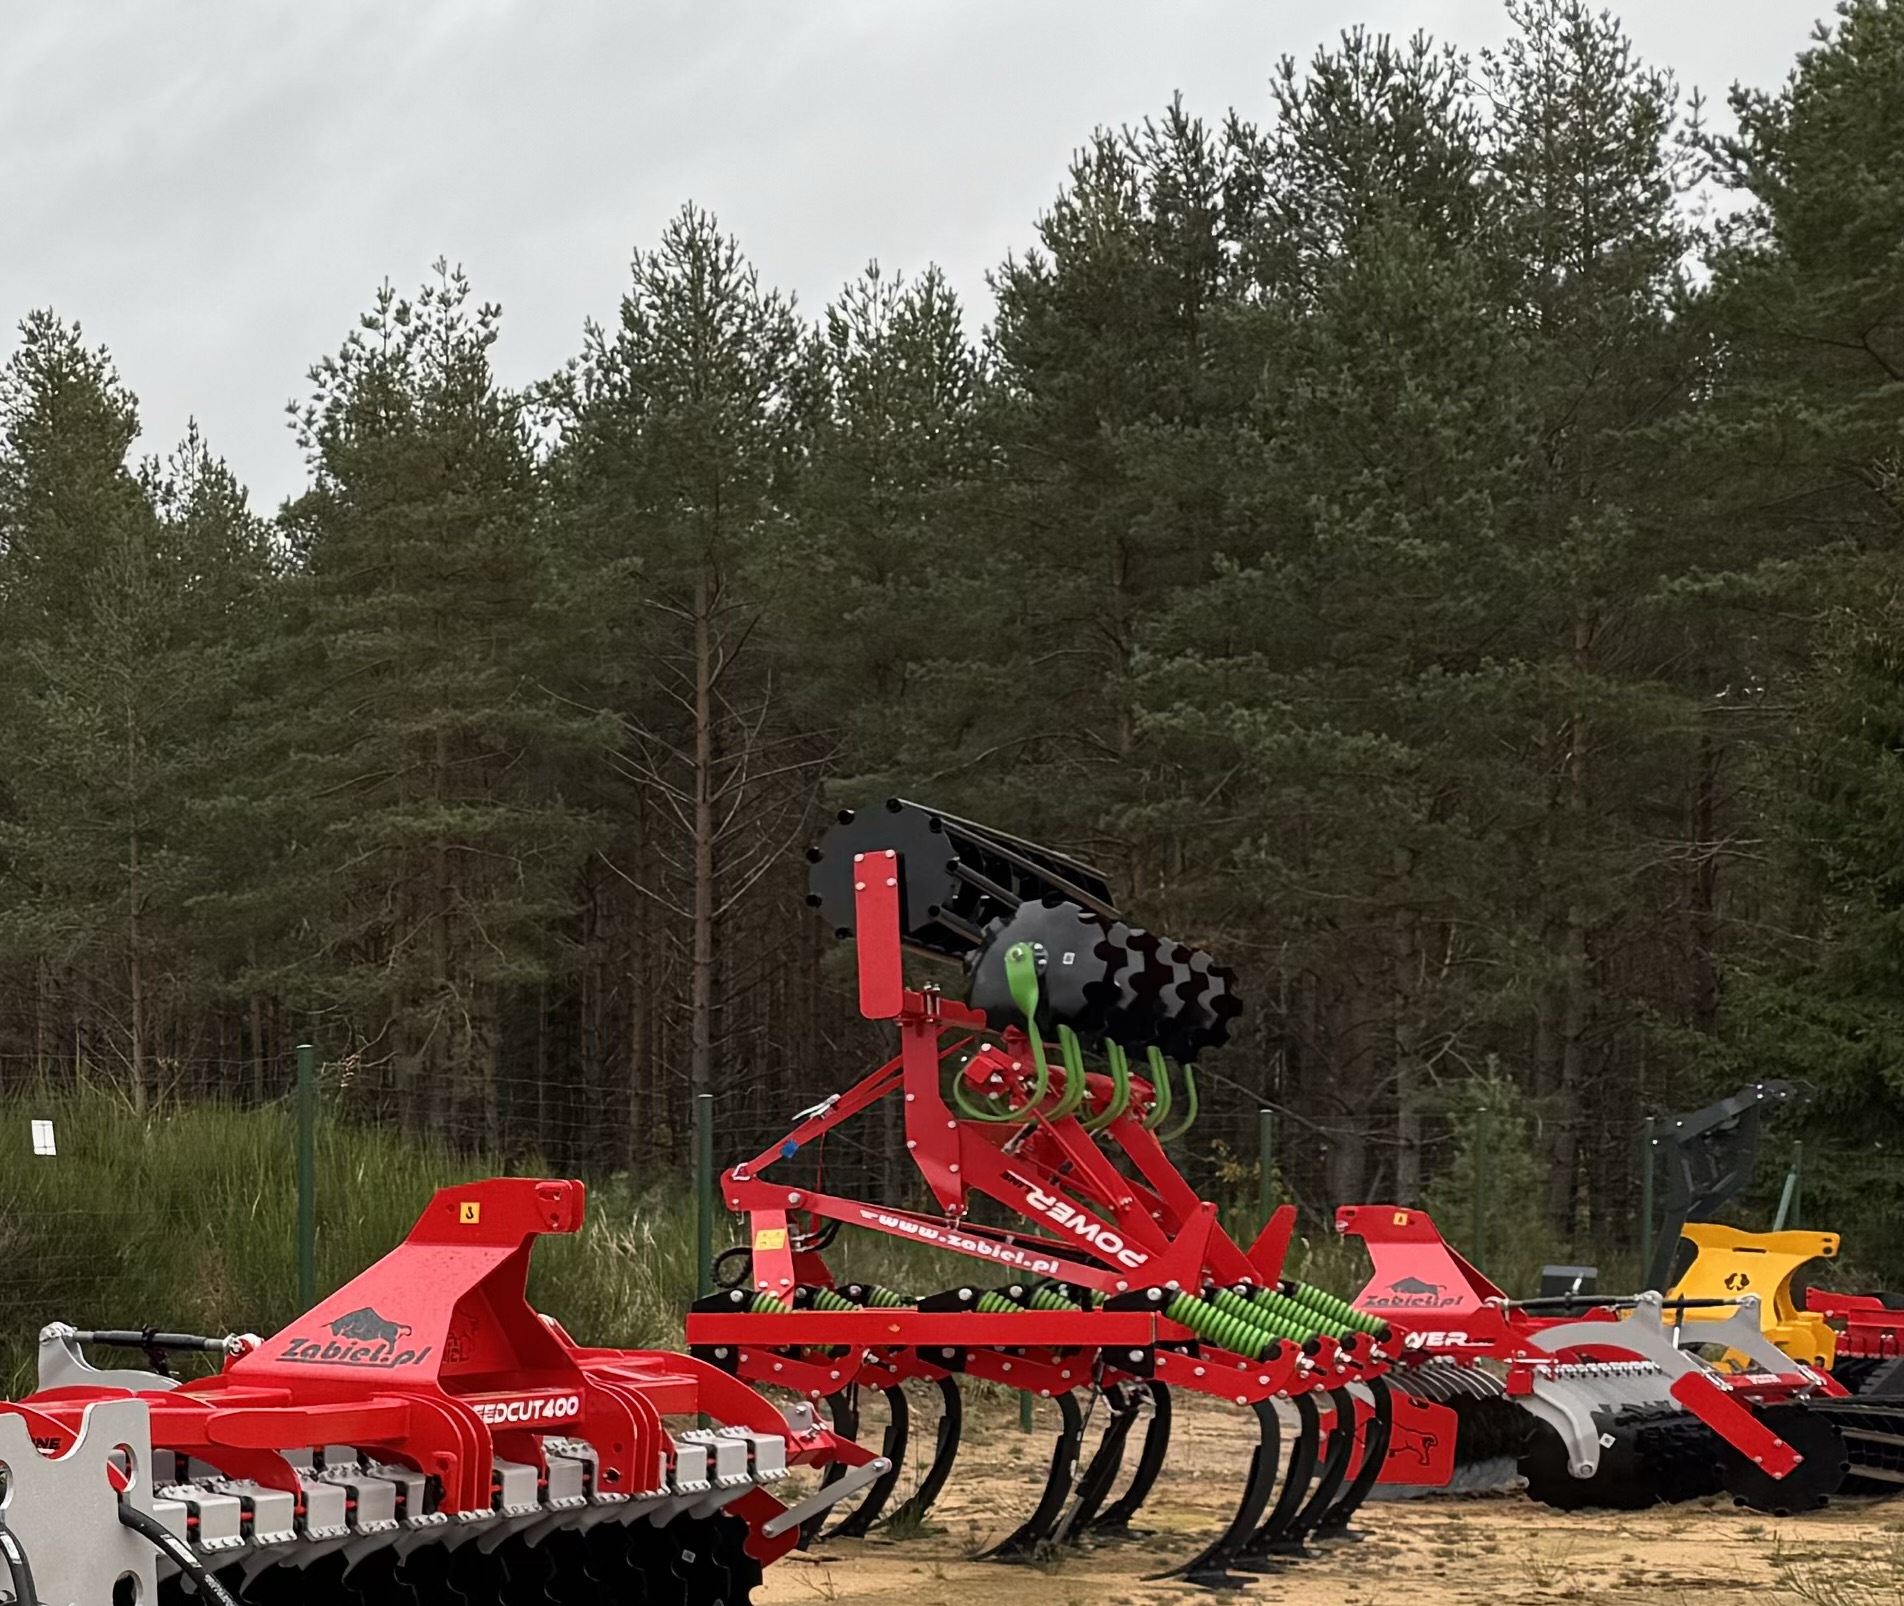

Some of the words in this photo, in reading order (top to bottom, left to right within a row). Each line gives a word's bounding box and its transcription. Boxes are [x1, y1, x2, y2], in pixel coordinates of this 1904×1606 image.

[879, 1213, 1059, 1274] www.zabiel.pl
[1016, 1178, 1149, 1268] POWER
[278, 1338, 432, 1368] Zabiel.pl
[473, 1396, 579, 1424] EEDCUT400
